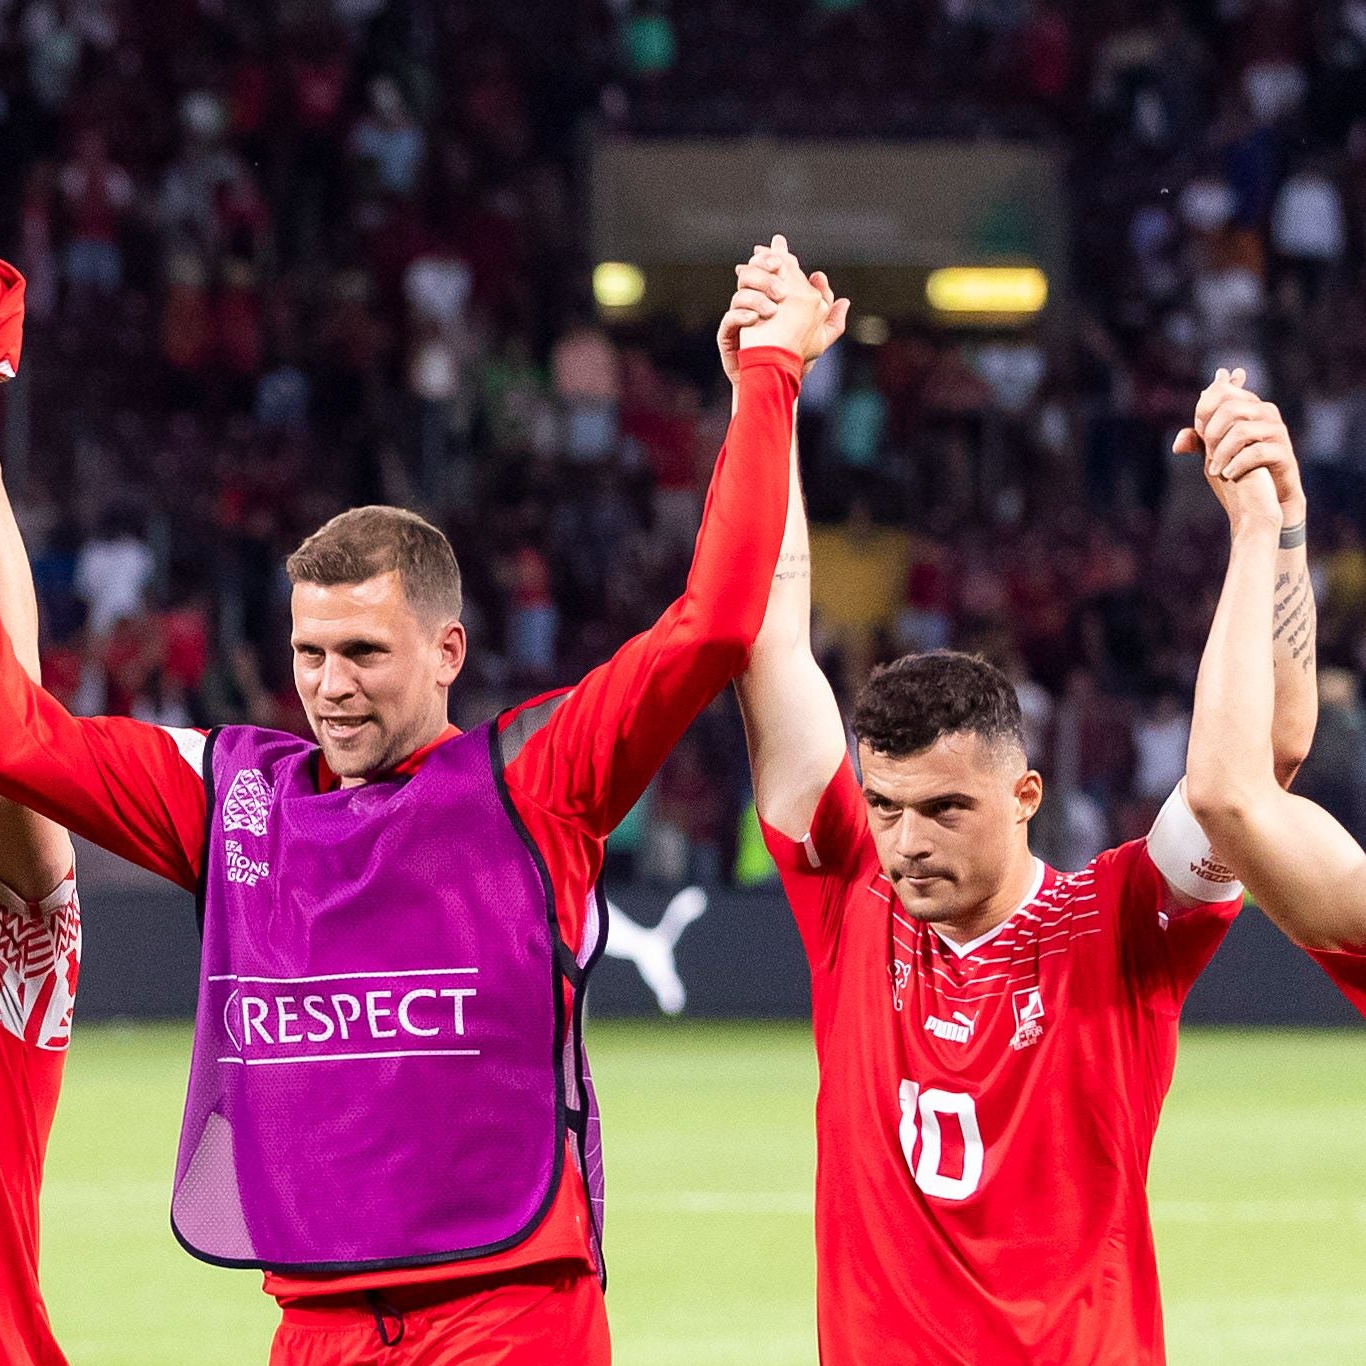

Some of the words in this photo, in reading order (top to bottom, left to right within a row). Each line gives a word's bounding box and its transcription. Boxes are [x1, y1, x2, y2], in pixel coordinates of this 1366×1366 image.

[225, 839, 243, 855] EFA
[226, 851, 270, 878] TIONS
[227, 867, 259, 887] GUE
[241, 988, 477, 1045] RESPECT
[898, 1078, 985, 1201] 10
